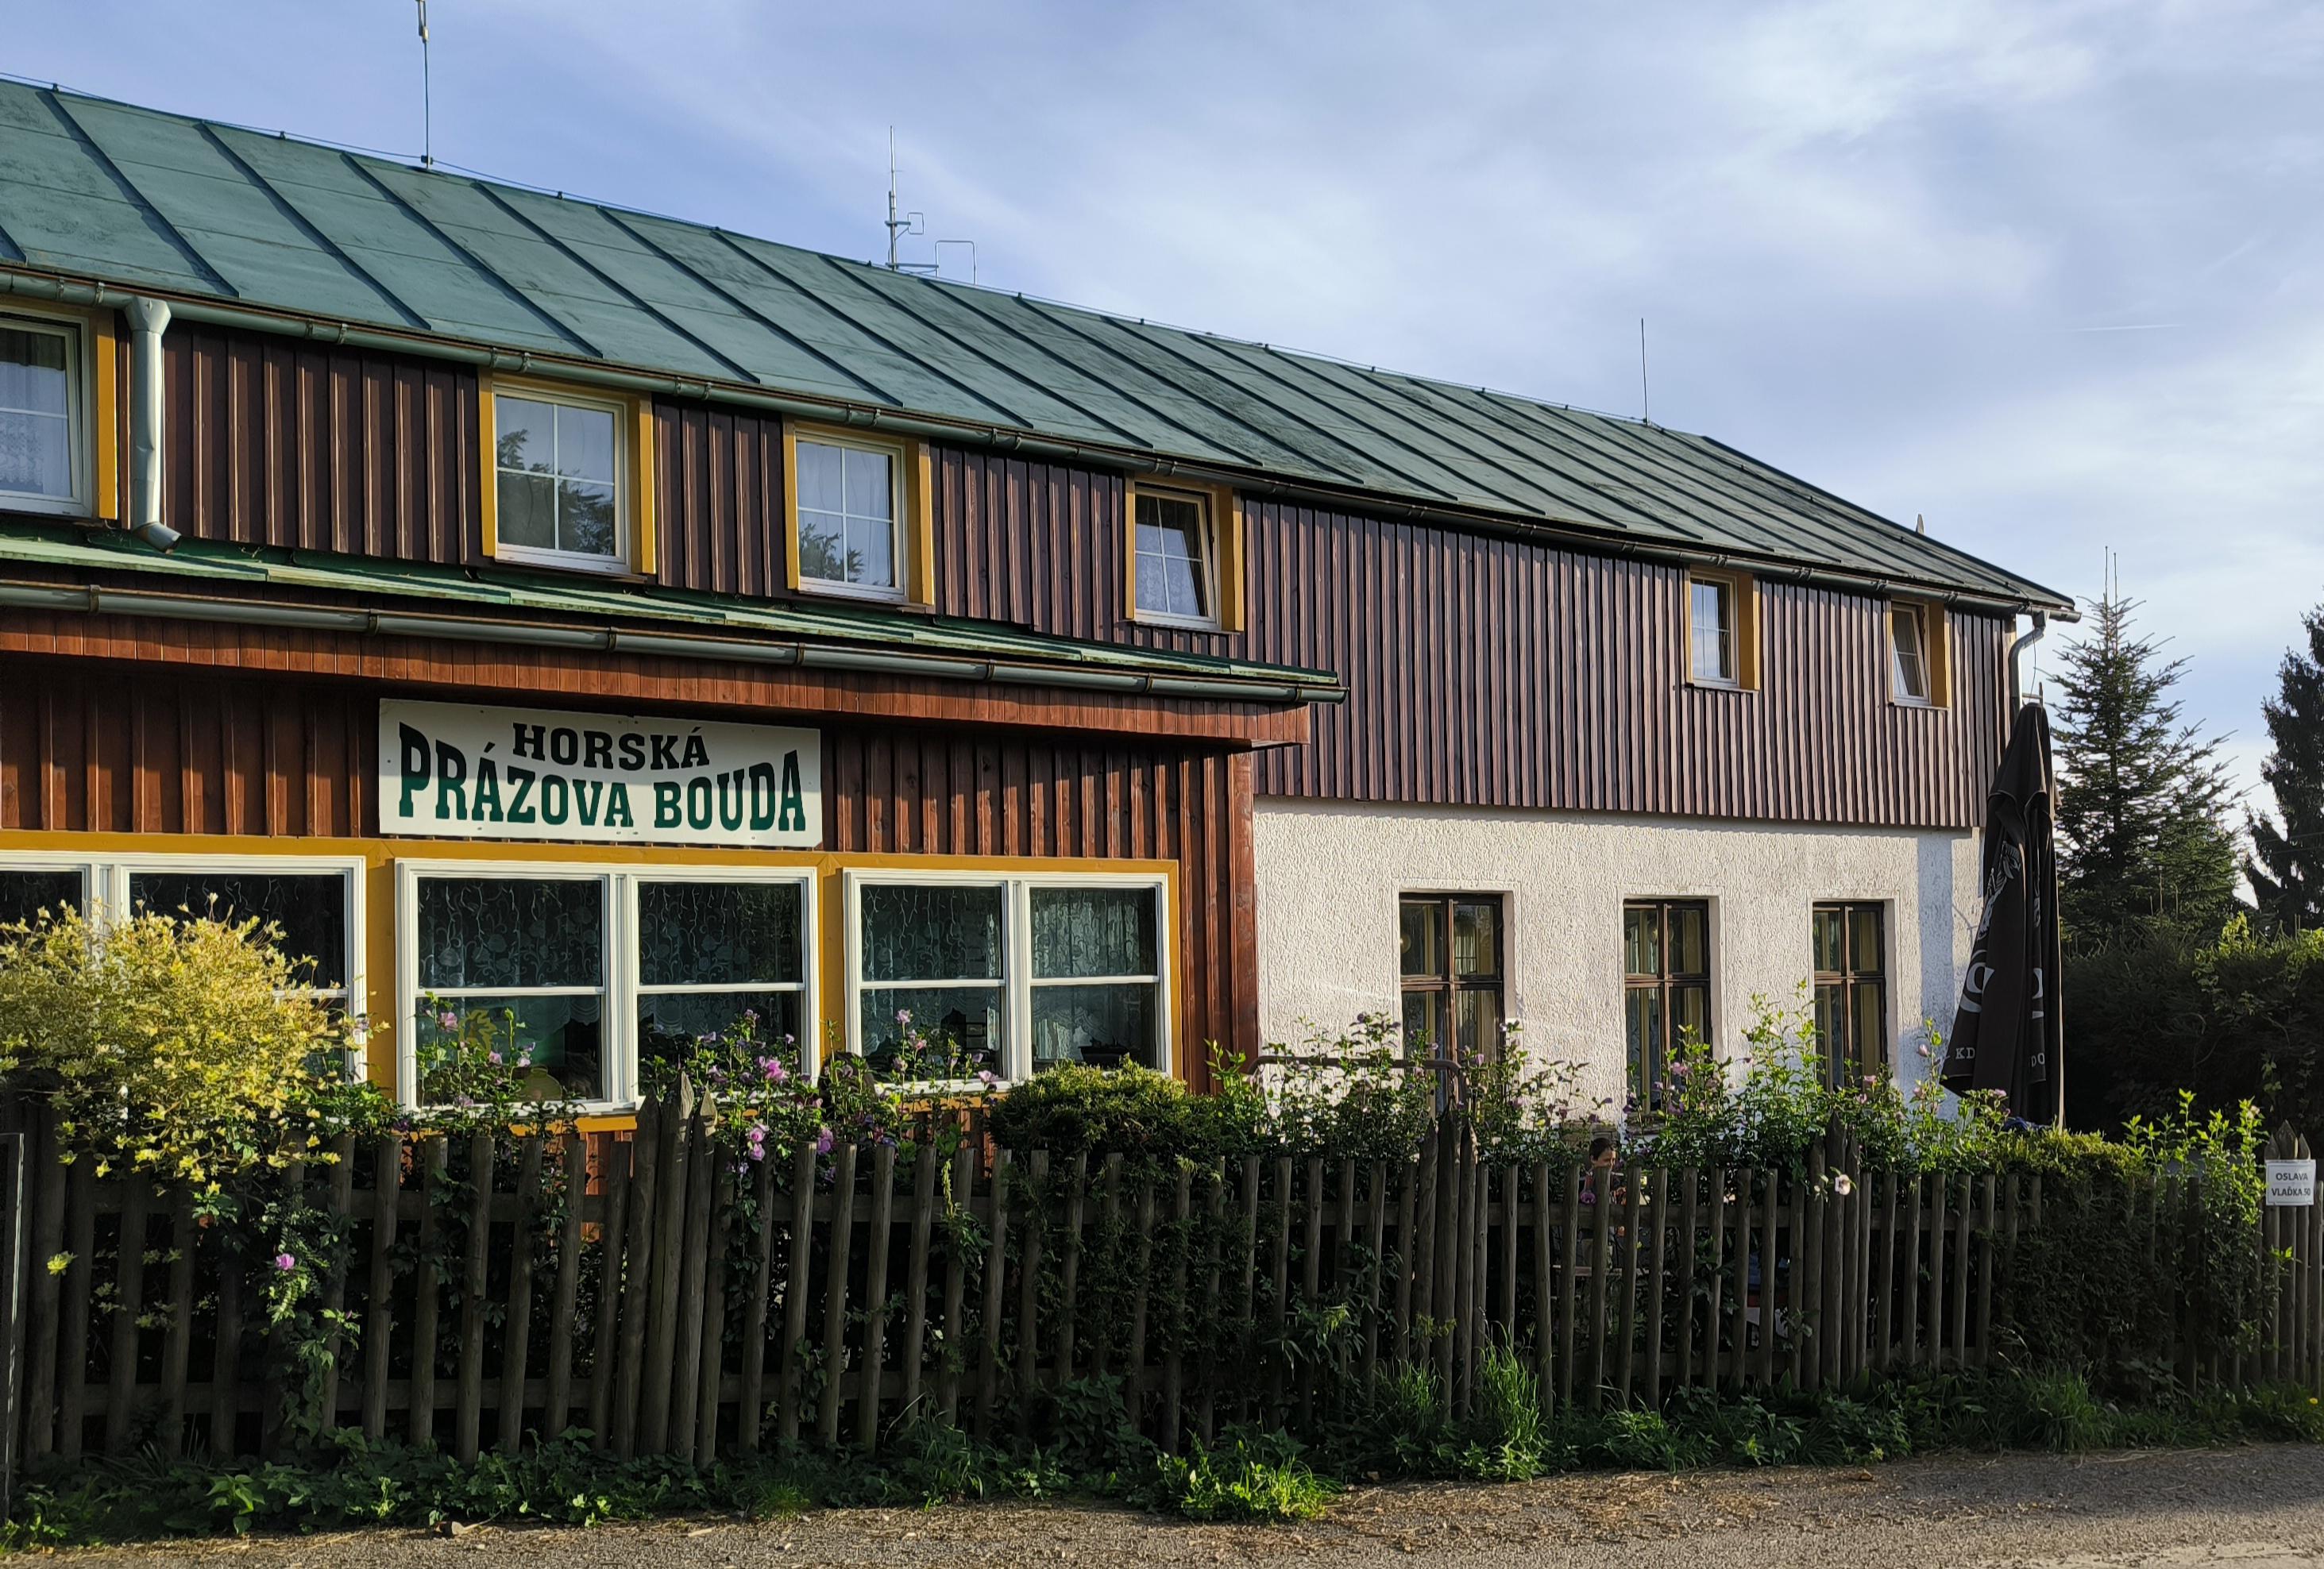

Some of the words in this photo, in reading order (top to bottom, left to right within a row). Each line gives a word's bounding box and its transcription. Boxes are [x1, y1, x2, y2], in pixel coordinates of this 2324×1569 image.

[399, 721, 634, 827] PRÁZOVA
[653, 749, 806, 831] BOUDA
[512, 722, 710, 771] HORSKÁ
